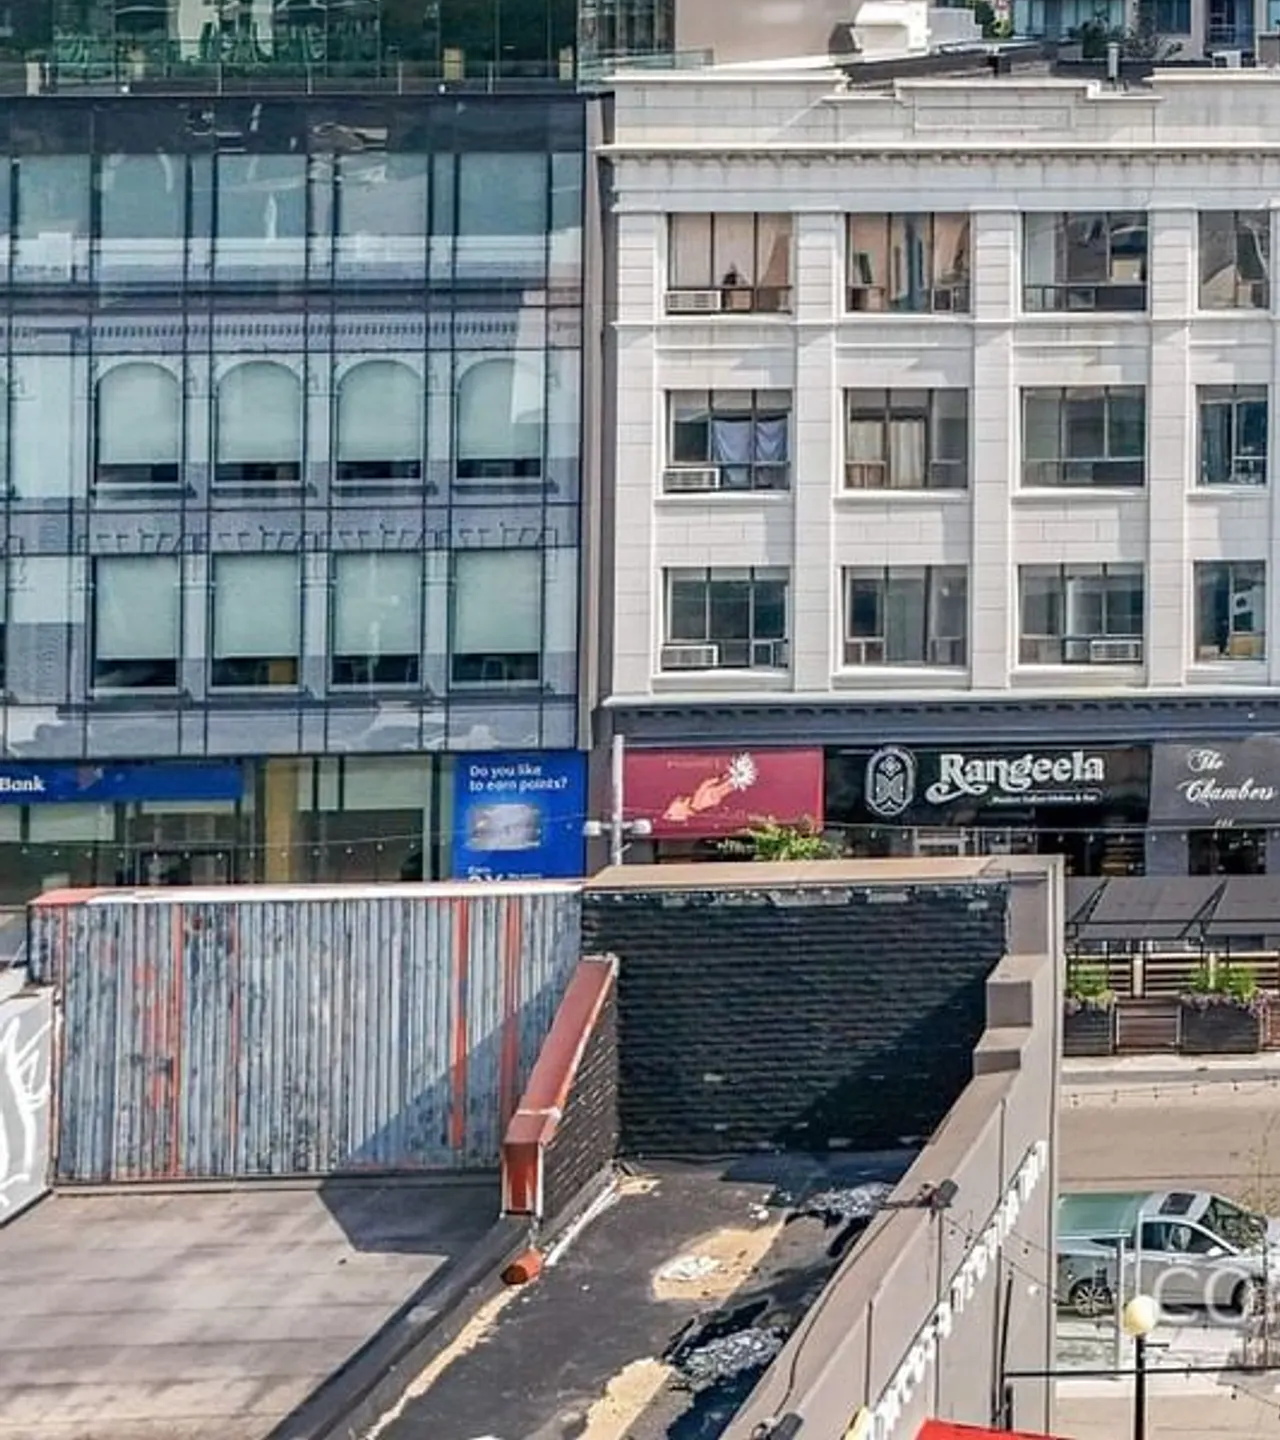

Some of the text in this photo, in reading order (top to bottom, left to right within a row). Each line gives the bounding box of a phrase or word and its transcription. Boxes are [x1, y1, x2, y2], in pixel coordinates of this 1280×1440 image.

[470, 763, 542, 779] Do you like
[925, 750, 1106, 804] Rangeela
[0, 774, 46, 792] Bank
[470, 776, 568, 793] to earn points?
[1176, 777, 1279, 809] Chambers
